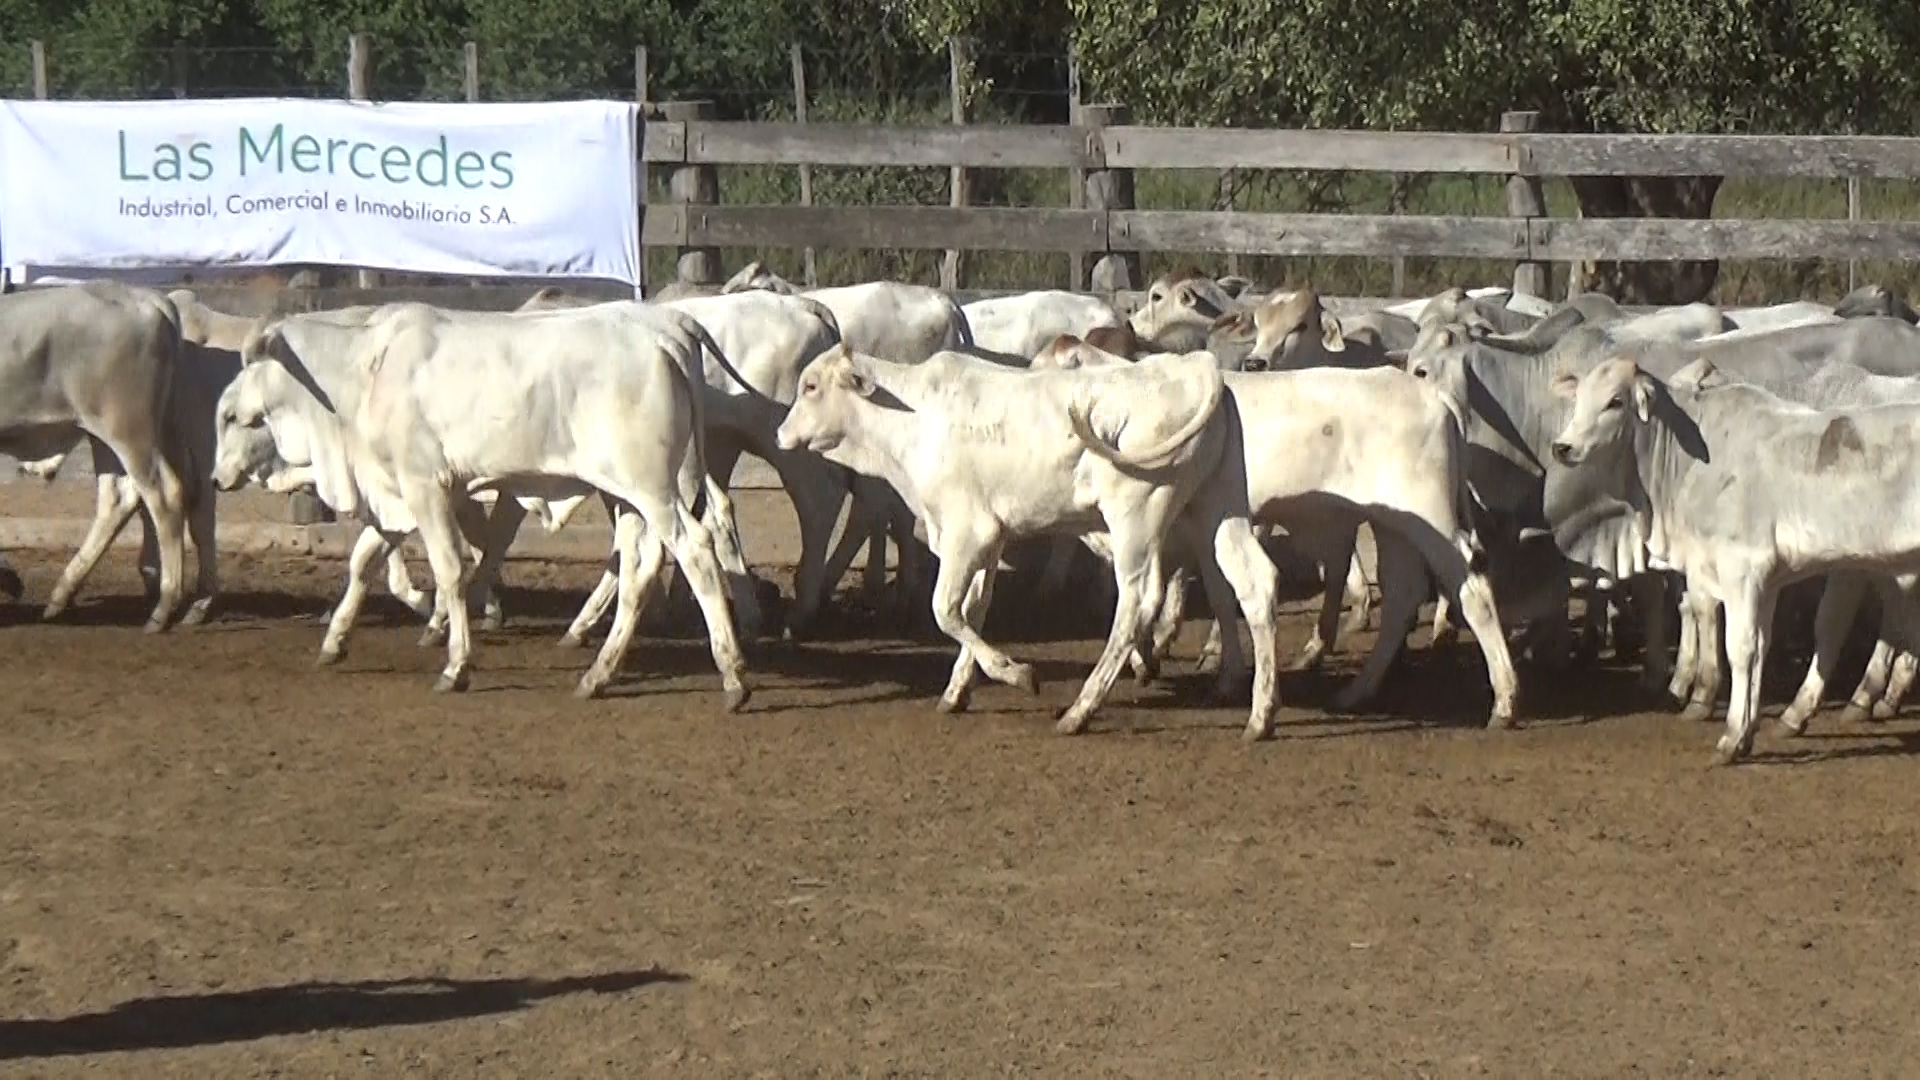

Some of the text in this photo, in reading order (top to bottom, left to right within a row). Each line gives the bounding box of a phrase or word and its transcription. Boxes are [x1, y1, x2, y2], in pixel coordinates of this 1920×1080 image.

[118, 122, 515, 190] Las Mercedes
[118, 189, 517, 225] Industrial, Comercial e Inmobiliaria S.A.
